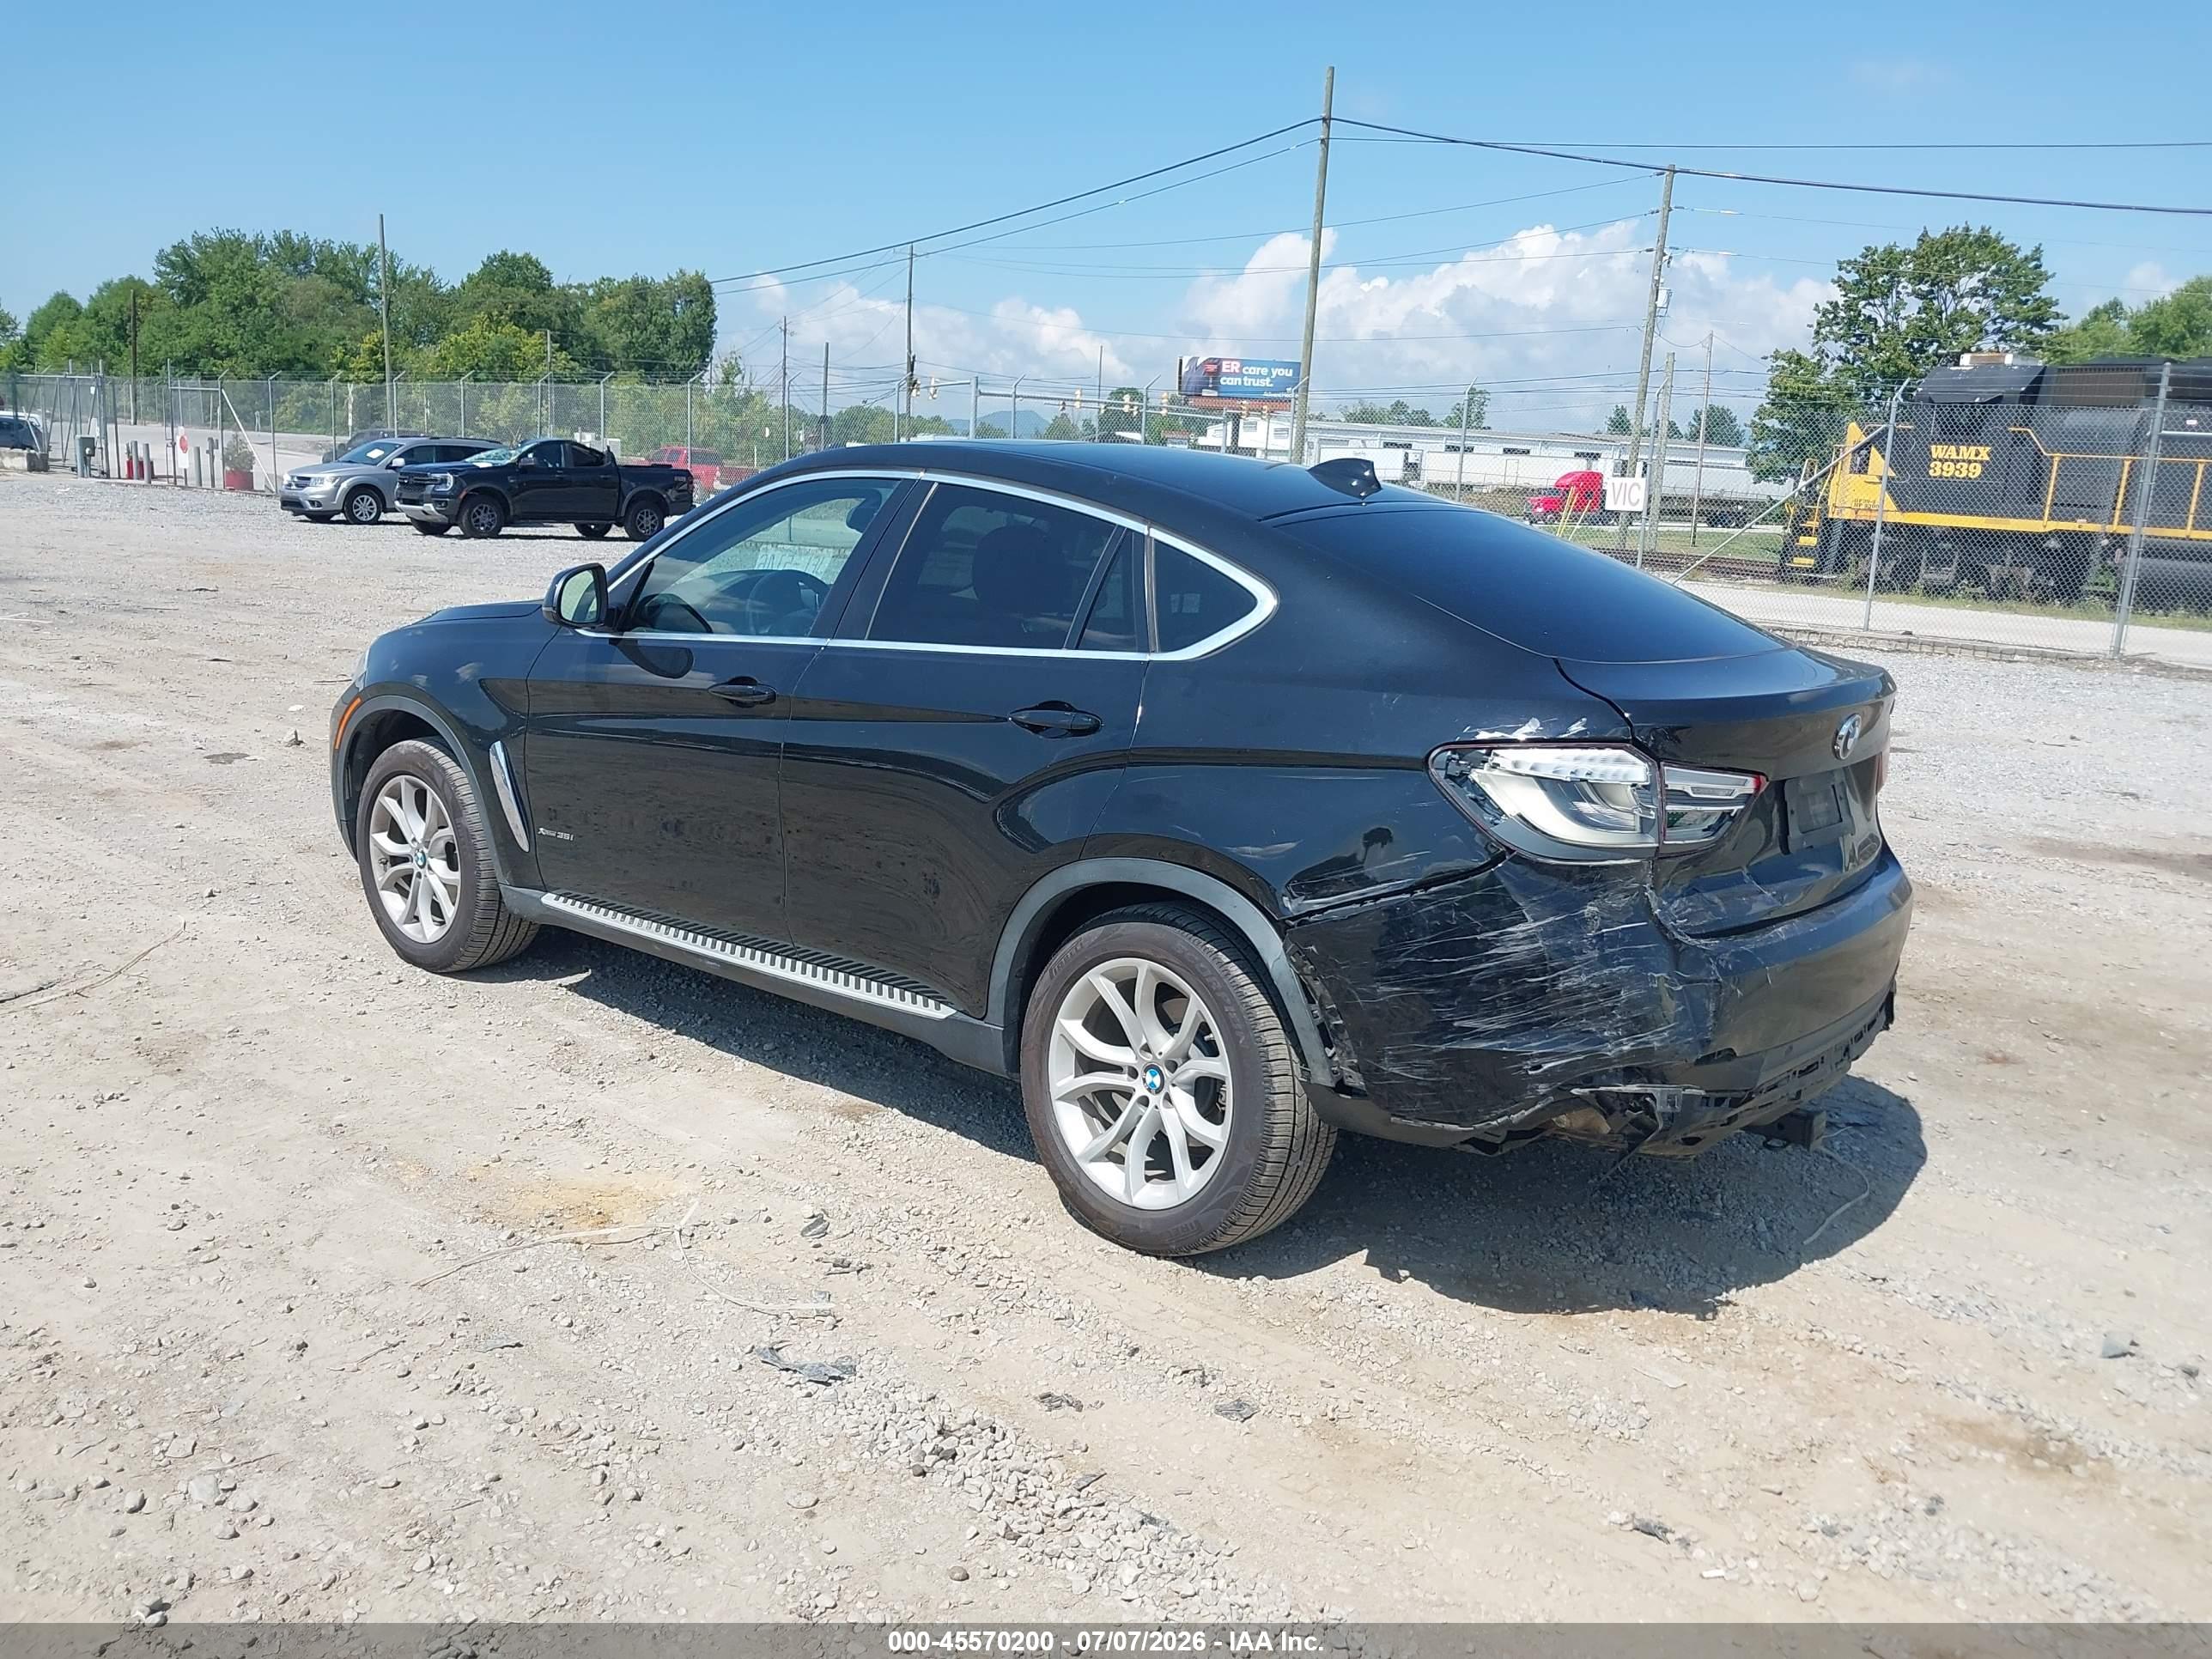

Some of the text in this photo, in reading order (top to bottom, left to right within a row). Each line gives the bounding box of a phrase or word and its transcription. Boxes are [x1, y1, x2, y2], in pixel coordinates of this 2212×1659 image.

[1221, 361, 1293, 378] ER care you
[1219, 376, 1274, 387] can trust.
[1929, 445, 1991, 460] WAMX
[1929, 461, 1982, 478] 3939
[1611, 482, 1641, 507] VIC
